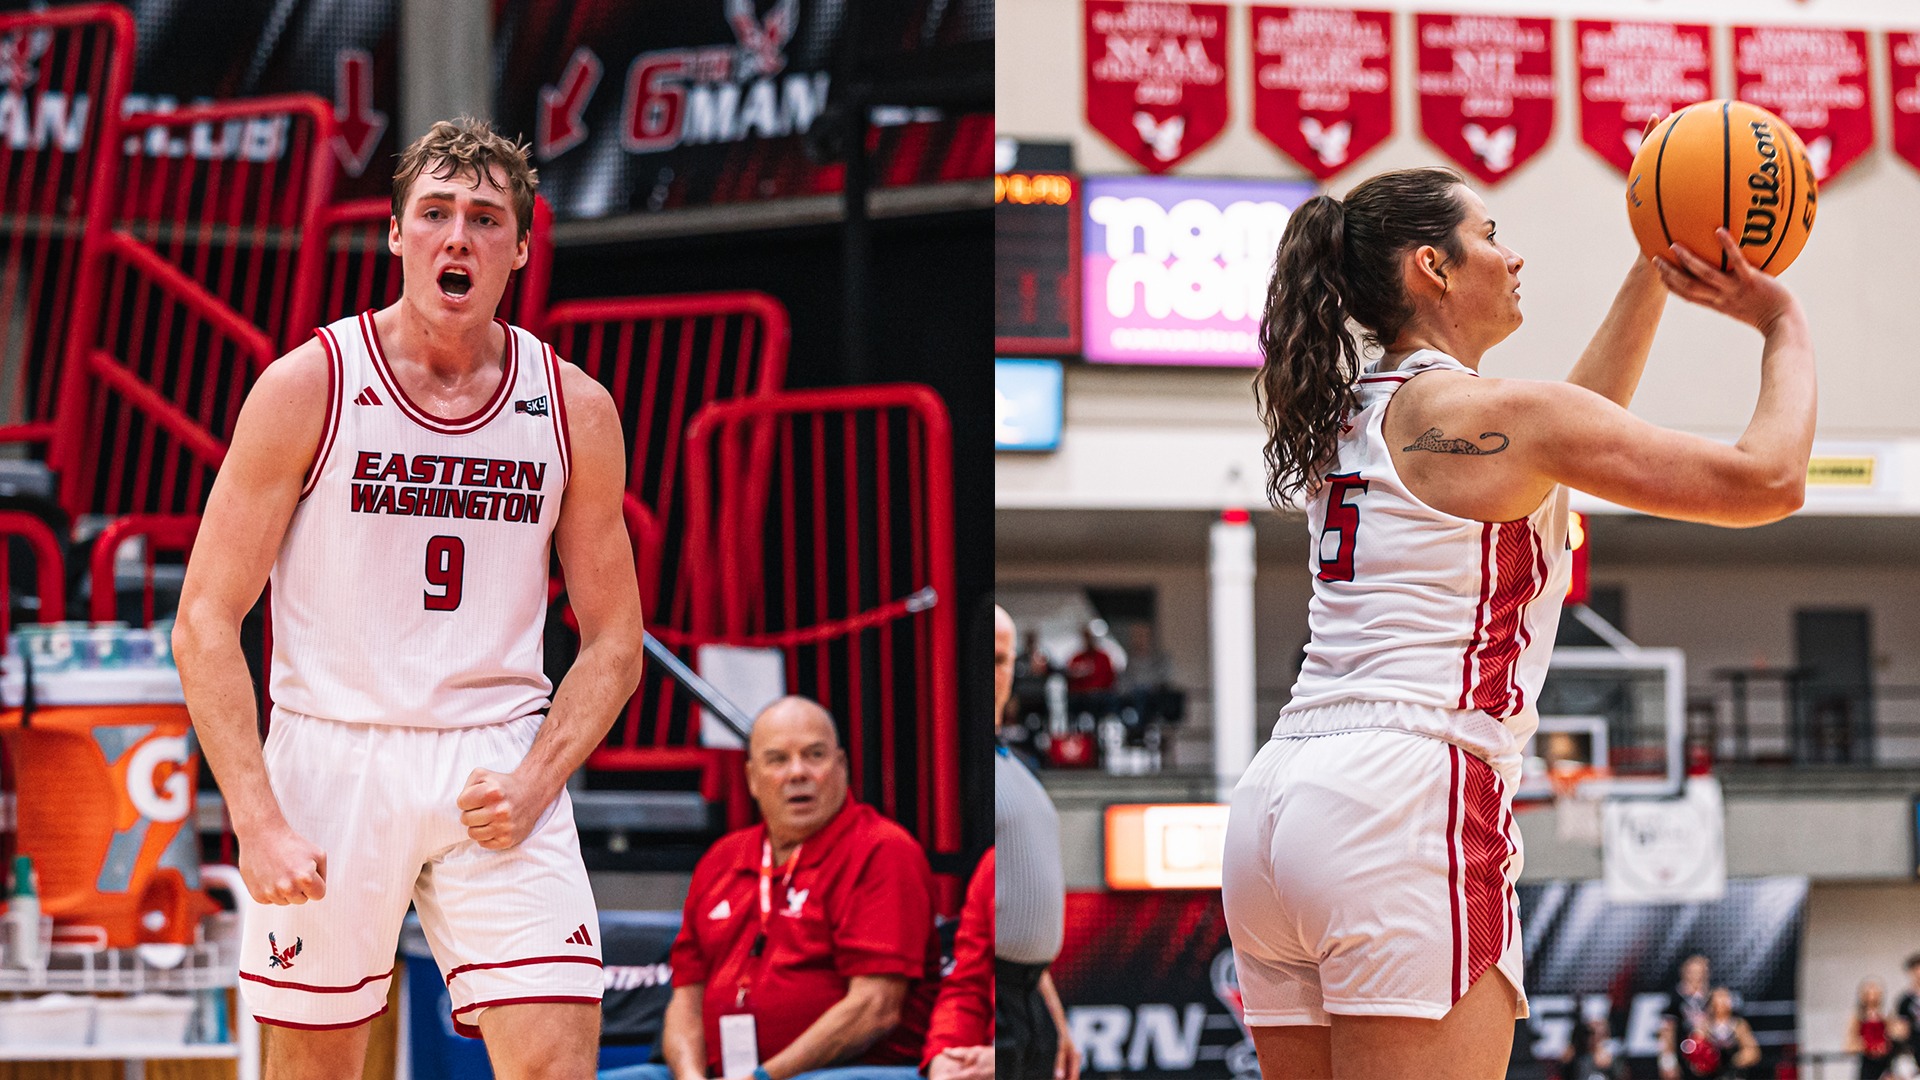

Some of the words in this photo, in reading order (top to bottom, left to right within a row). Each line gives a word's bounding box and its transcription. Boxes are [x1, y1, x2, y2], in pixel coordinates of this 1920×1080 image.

[680, 72, 829, 146] MAN
[1739, 119, 1779, 250] Wilson
[526, 396, 547, 412] SKY
[350, 483, 545, 524] WASHINGTON
[352, 450, 547, 491] EASTERN
[424, 534, 465, 611] 9
[126, 735, 191, 823] G
